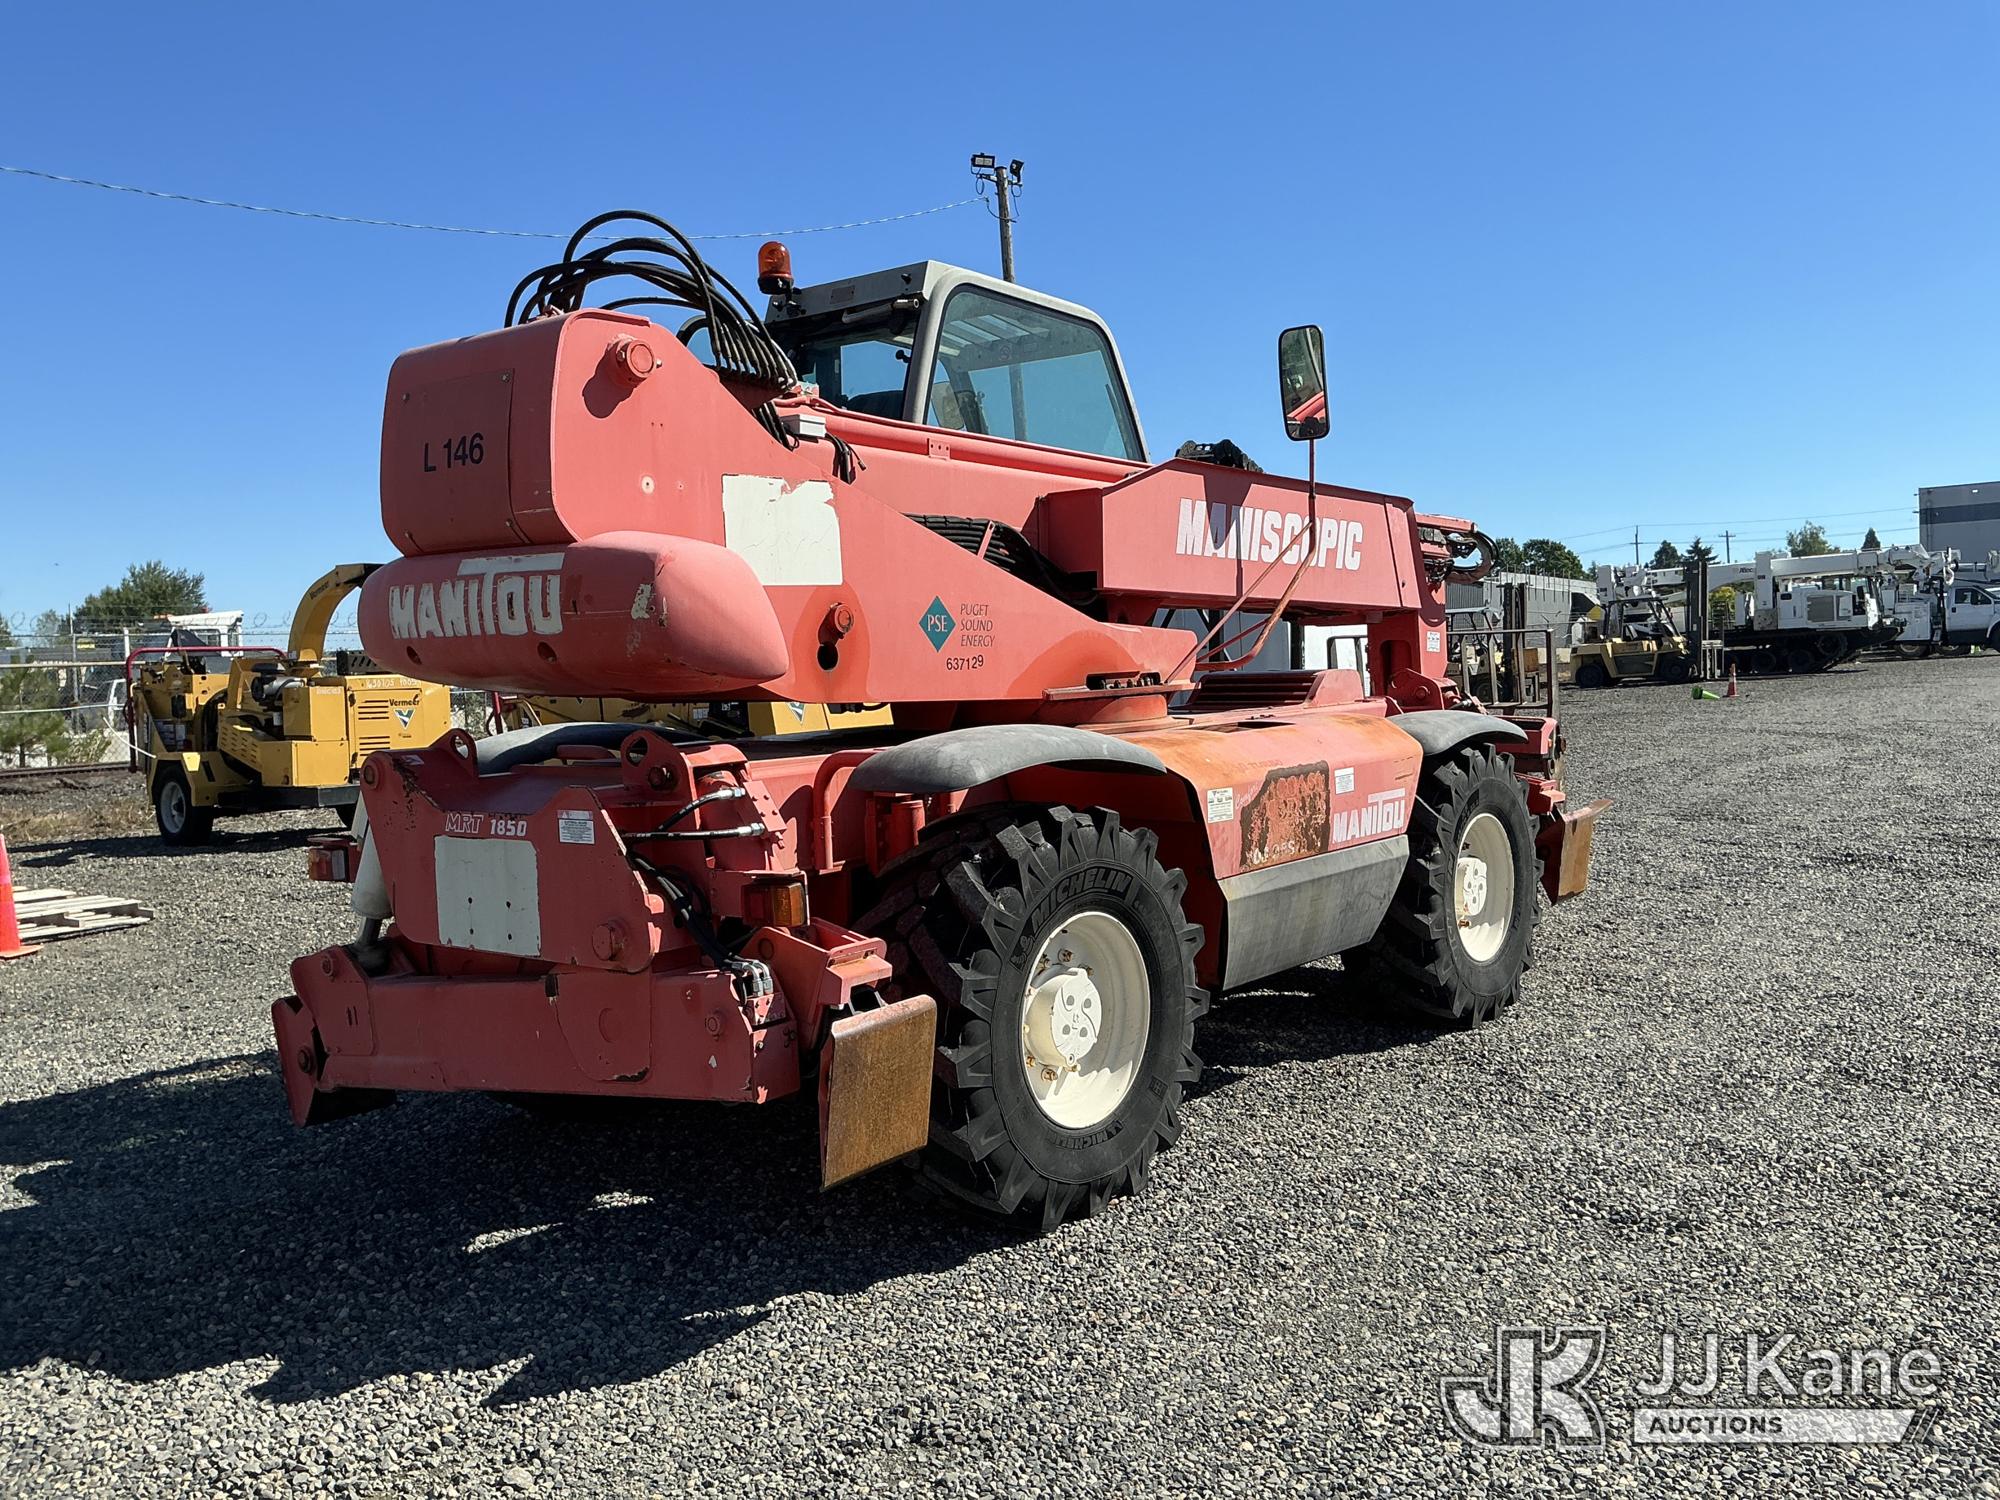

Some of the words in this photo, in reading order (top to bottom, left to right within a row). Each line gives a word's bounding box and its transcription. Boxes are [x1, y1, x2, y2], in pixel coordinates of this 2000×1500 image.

[423, 441, 437, 473] L
[442, 432, 485, 470] 146
[1175, 497, 1364, 571] MANISCOPIC
[389, 552, 565, 639] MANITOU
[959, 603, 990, 617] PUGET
[926, 614, 948, 632] PSE
[960, 618, 994, 632] SOUND
[960, 634, 996, 648] ENERGY
[946, 654, 984, 671] 637129
[388, 698, 420, 707] Vermeer
[445, 812, 485, 834] MRT
[489, 818, 528, 837] 1850
[1332, 788, 1405, 844] MANITOU
[1031, 867, 1133, 934] MICHELIN
